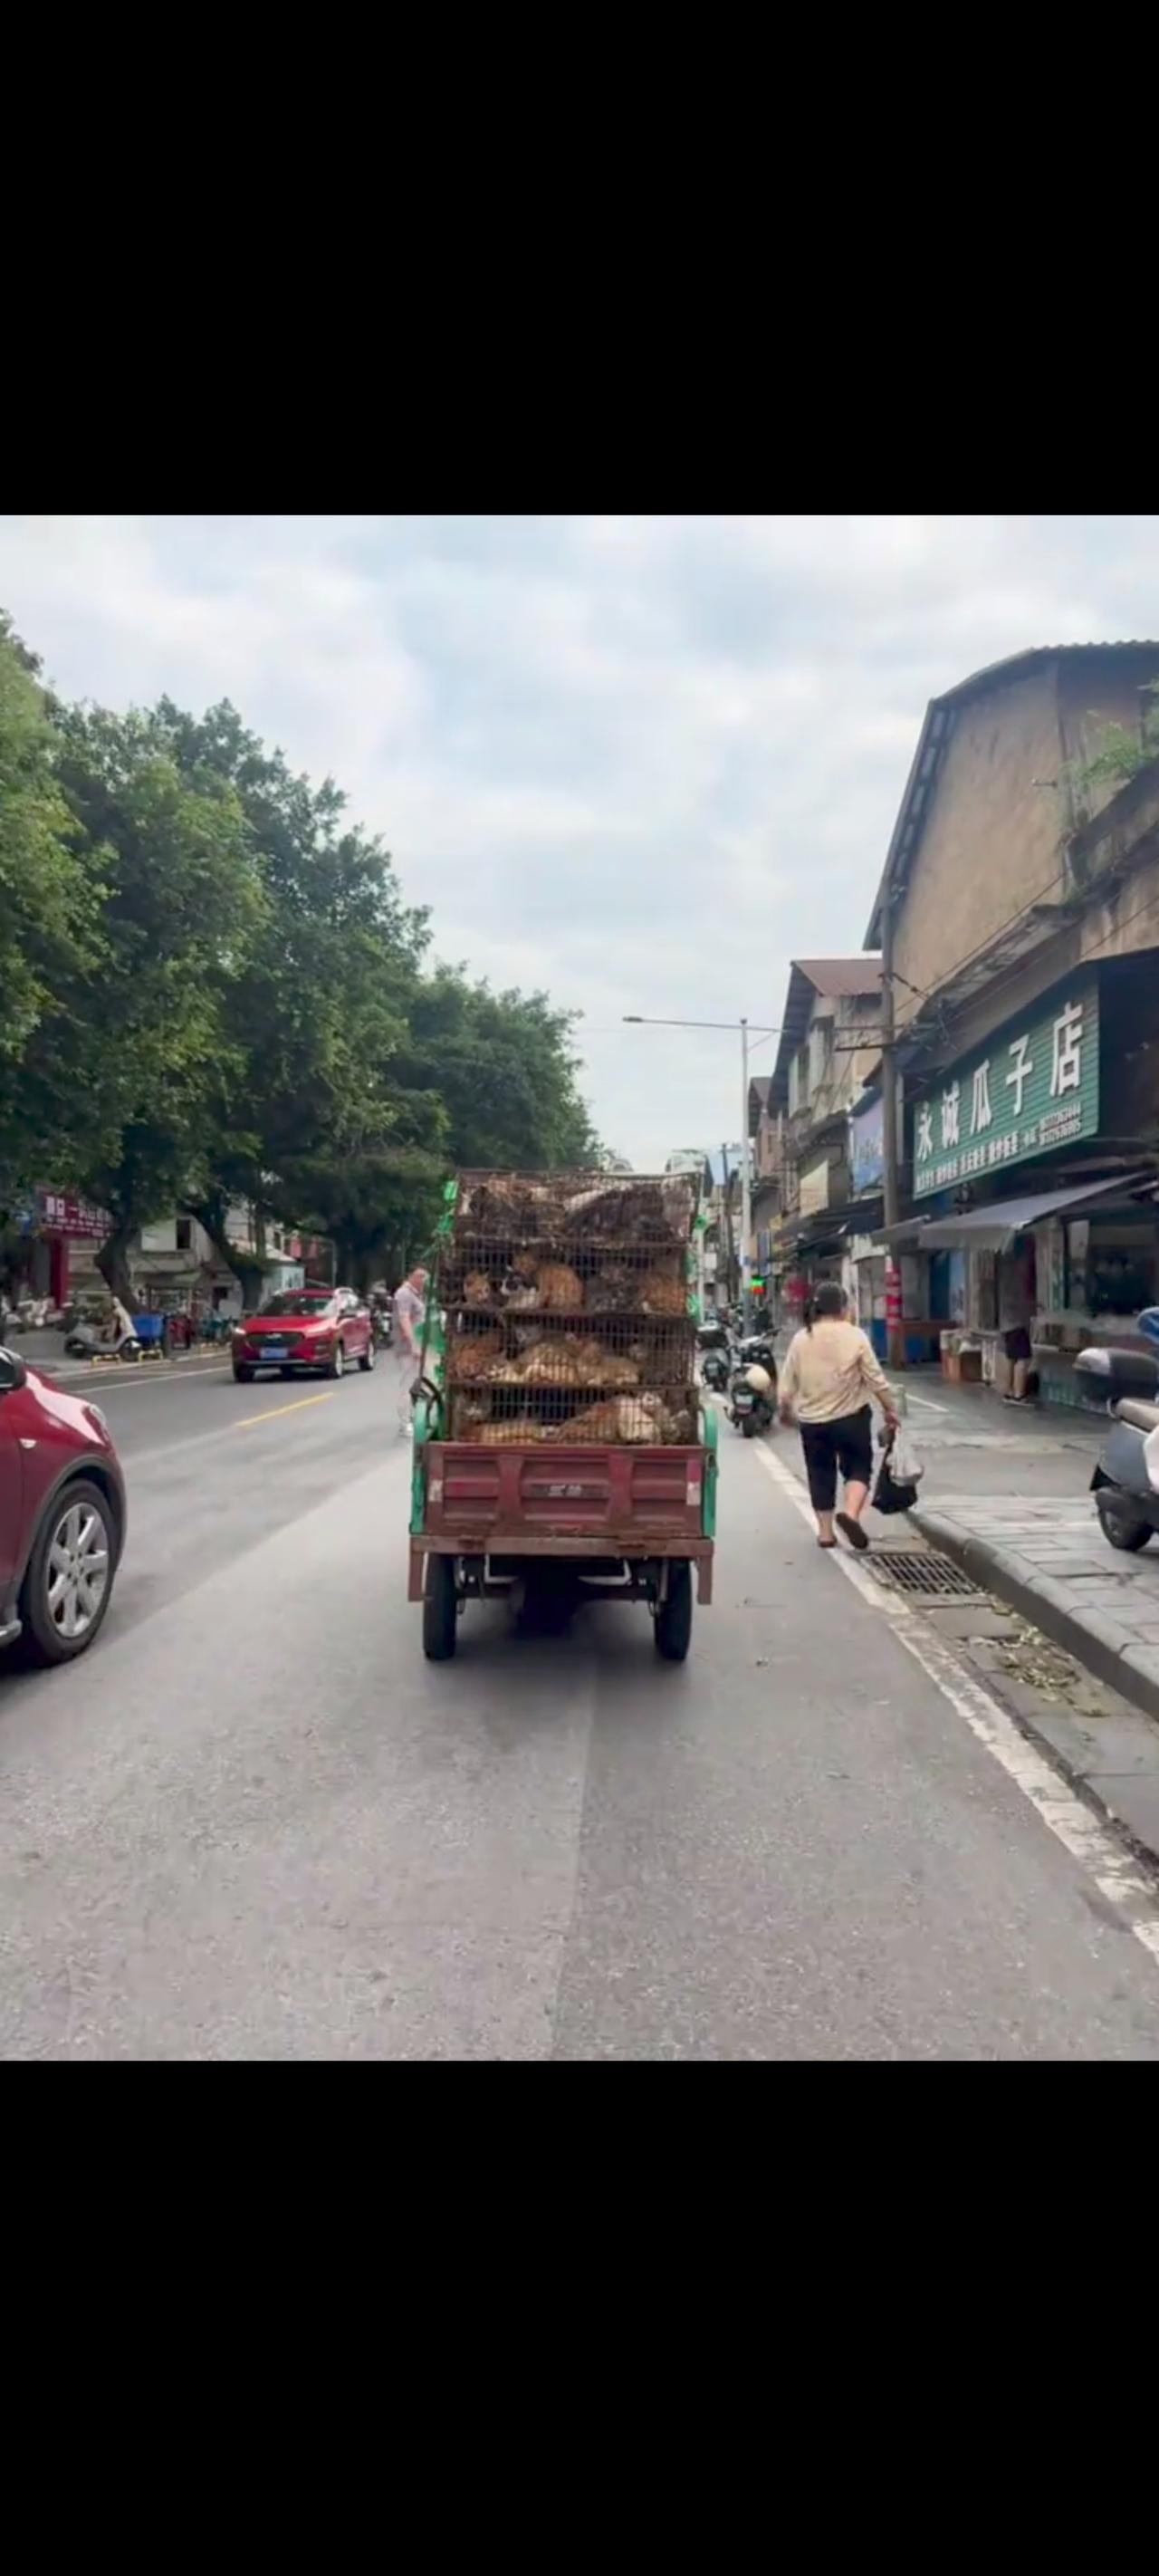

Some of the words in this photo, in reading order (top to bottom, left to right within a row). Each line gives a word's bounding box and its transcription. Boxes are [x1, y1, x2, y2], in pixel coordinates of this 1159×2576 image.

[917, 1002, 1083, 1162] 永诚瓜子店
